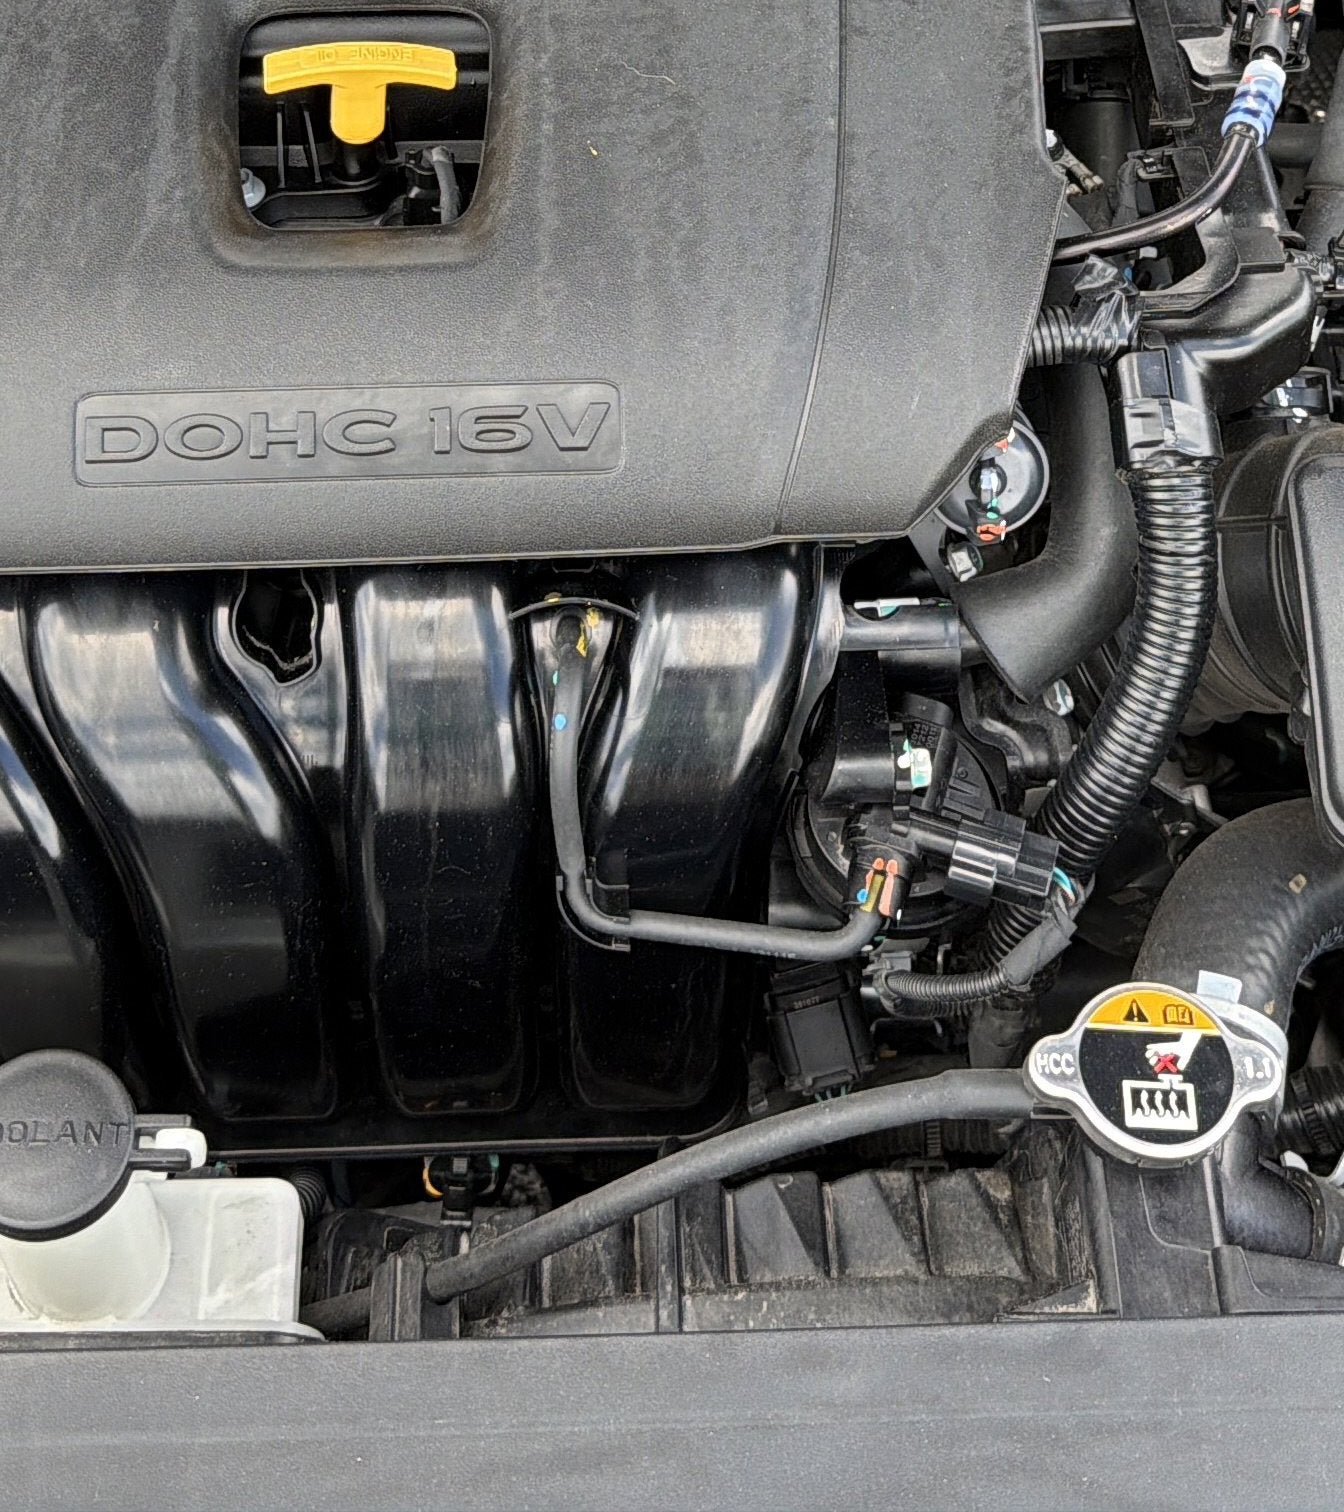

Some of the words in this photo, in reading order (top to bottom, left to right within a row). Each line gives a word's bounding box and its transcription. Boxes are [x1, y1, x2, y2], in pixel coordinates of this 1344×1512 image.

[84, 409, 396, 464] DOHC
[429, 402, 610, 454] 16V
[1035, 1052, 1075, 1076] HCC
[1244, 1057, 1271, 1079] 1.1
